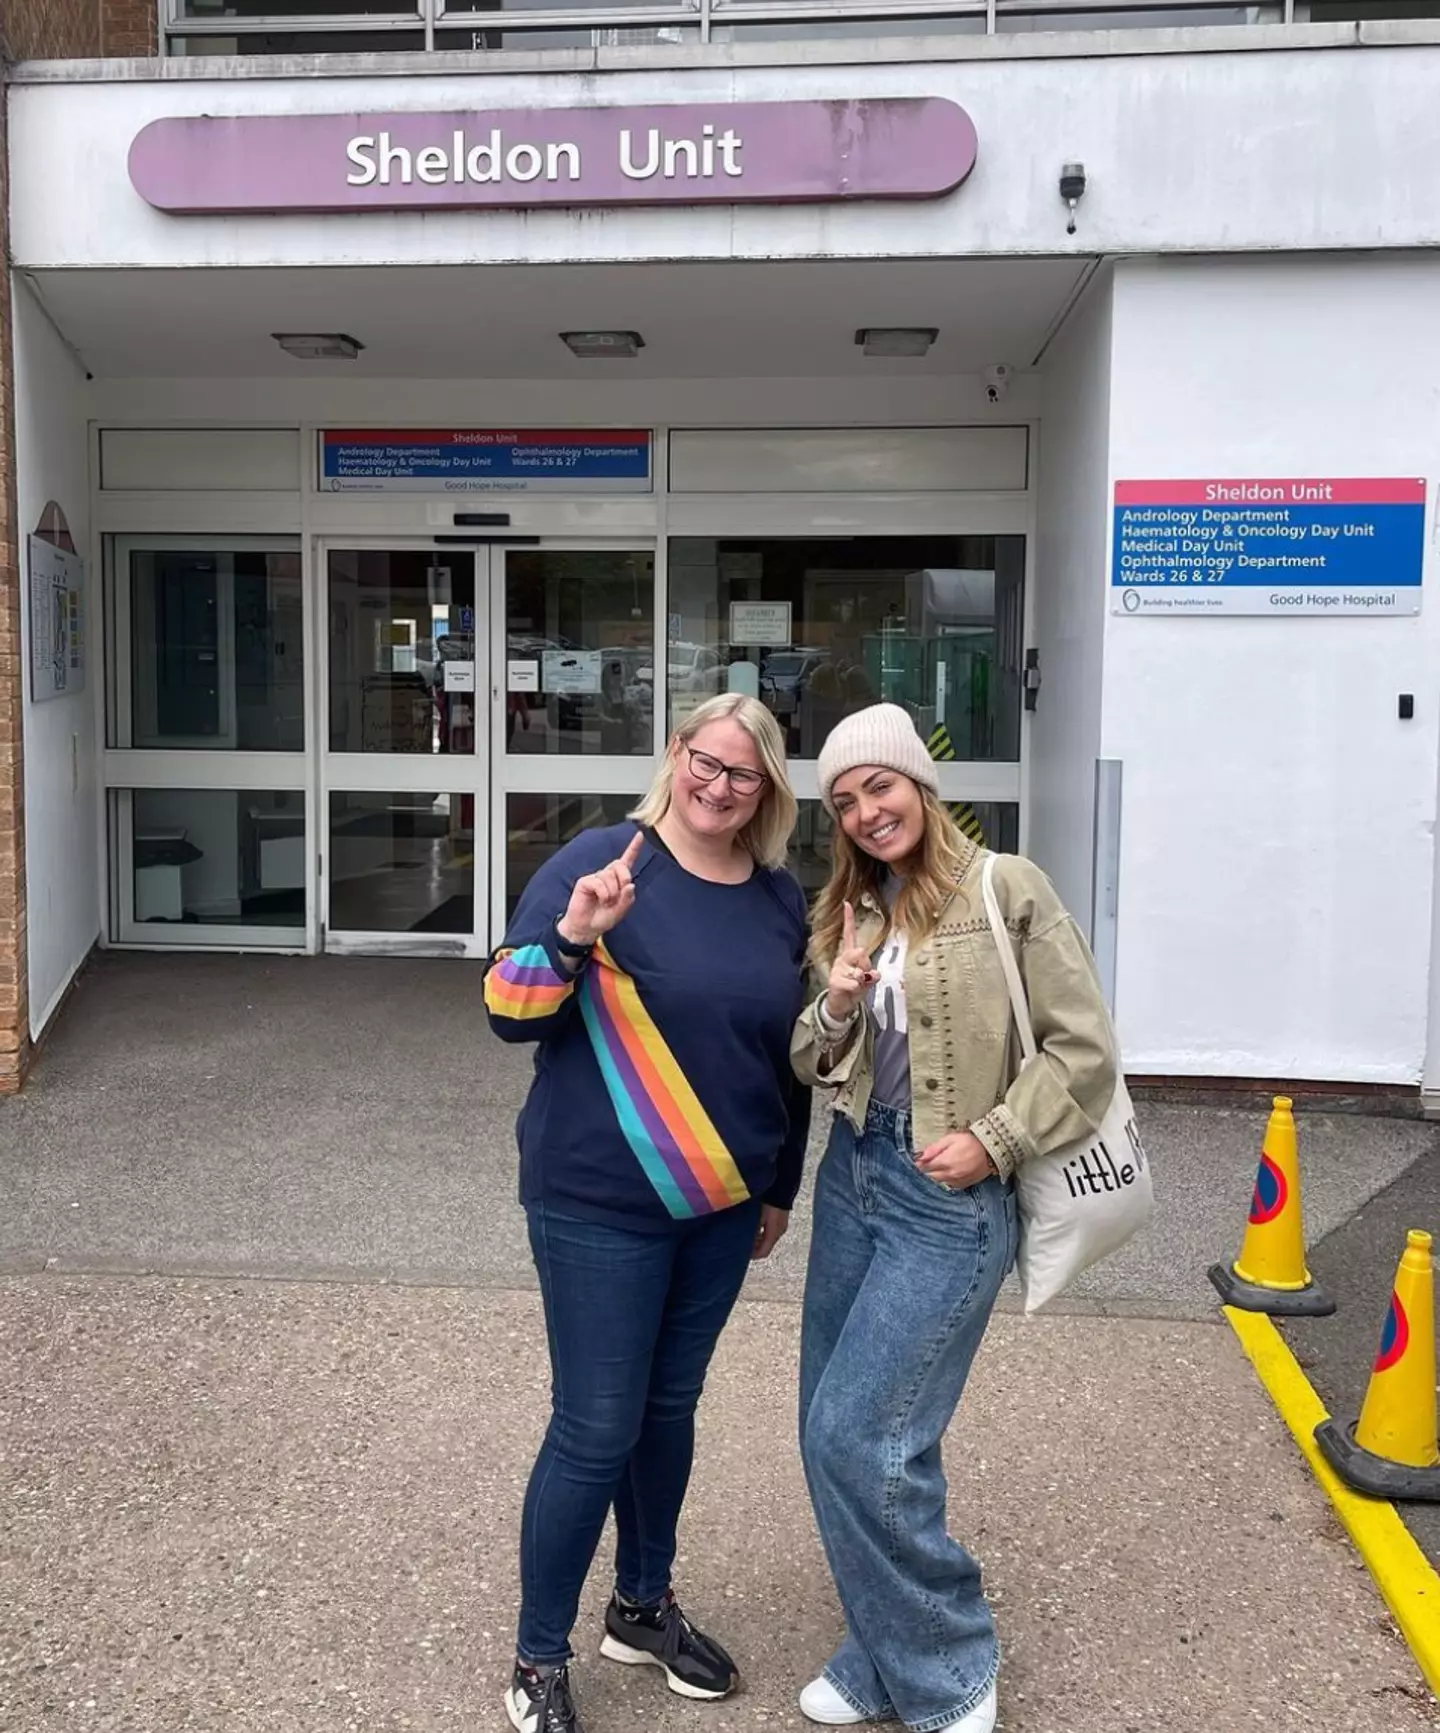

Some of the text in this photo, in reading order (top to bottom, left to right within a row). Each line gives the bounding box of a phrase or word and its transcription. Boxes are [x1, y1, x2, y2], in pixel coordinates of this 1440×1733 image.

[346, 125, 743, 186] Sheldon Unit
[452, 433, 518, 443] Sheldon Unit
[338, 447, 440, 458] Andrology Department
[511, 447, 639, 458] Ophthalmology Department
[338, 457, 492, 468] Haematology & Oncology Day Unit
[511, 457, 577, 466] Wards 26 & 27
[338, 466, 414, 477] Medical Day Unit
[444, 481, 527, 492] Good Hope Hospital
[1205, 483, 1333, 501] Sheldon Unit
[1121, 508, 1290, 524] Andrology Department
[1121, 523, 1375, 540] Haematology & Oncology Day Unit
[1121, 539, 1245, 555] Medical Day Unit
[1120, 554, 1326, 570] Ophthalmology Department
[1120, 569, 1225, 582] Wards 26 & 27
[1269, 593, 1396, 607] Good Hope Hospital
[1062, 1140, 1136, 1198] little
